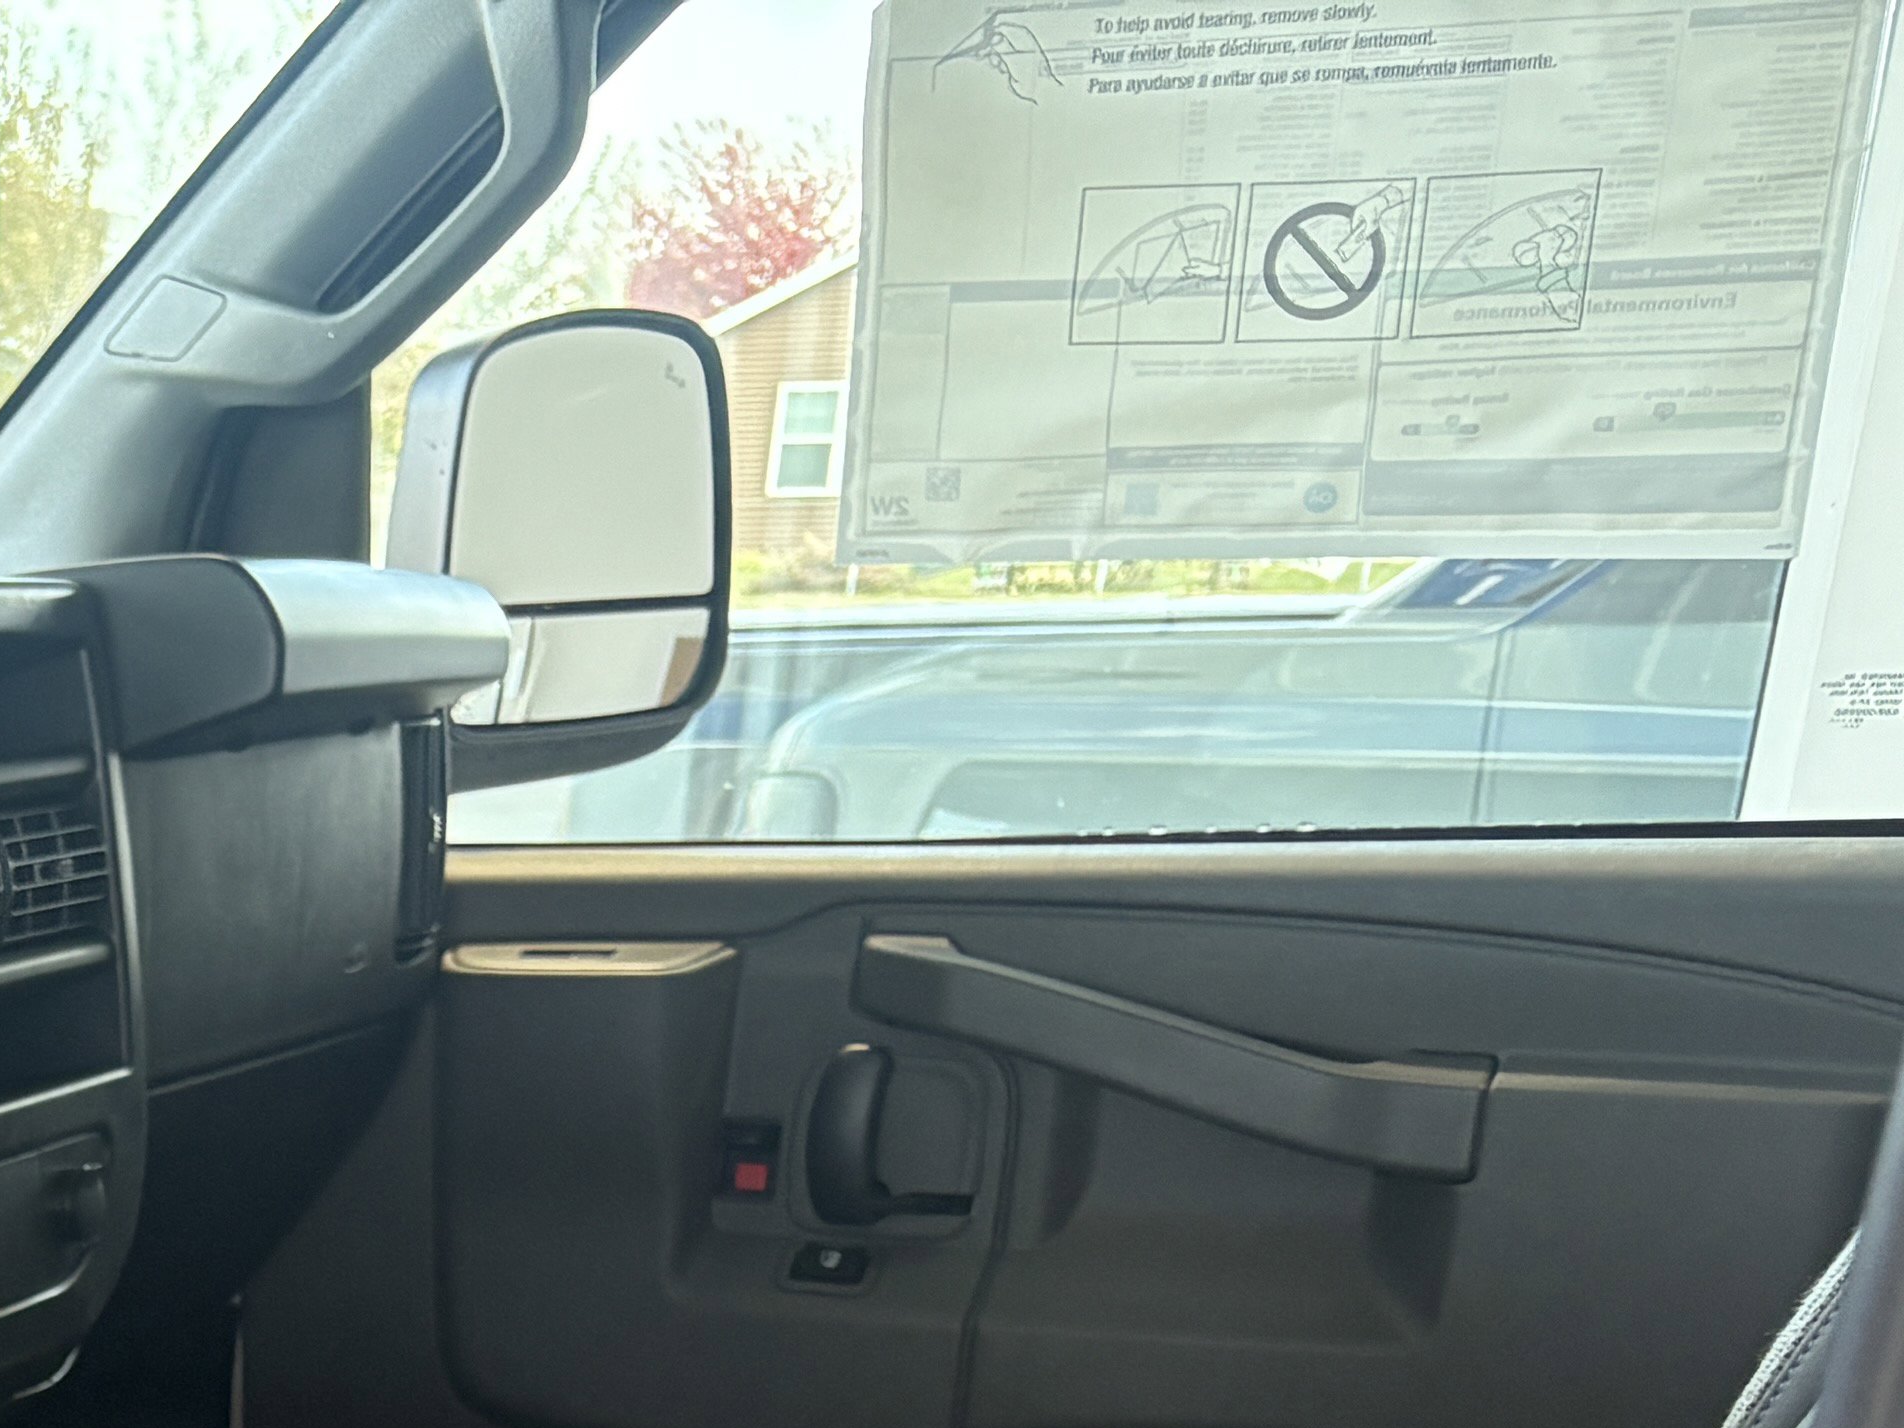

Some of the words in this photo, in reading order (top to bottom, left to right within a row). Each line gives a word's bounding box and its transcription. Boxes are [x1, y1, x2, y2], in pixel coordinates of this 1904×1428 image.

[1095, 17, 1113, 34] To
[1116, 16, 1150, 35] help
[1154, 12, 1194, 31] avoid
[1197, 10, 1257, 29] tearing,
[1261, 6, 1318, 25] remove
[1323, 3, 1377, 22] slowly.
[1091, 47, 1124, 64] Pour
[1176, 42, 1214, 61] toute
[1087, 78, 1122, 94] Para
[1125, 74, 1196, 95] ayudarse
[1212, 69, 1257, 88] evitar
[1259, 70, 1289, 87] que
[1292, 68, 1311, 82] se
